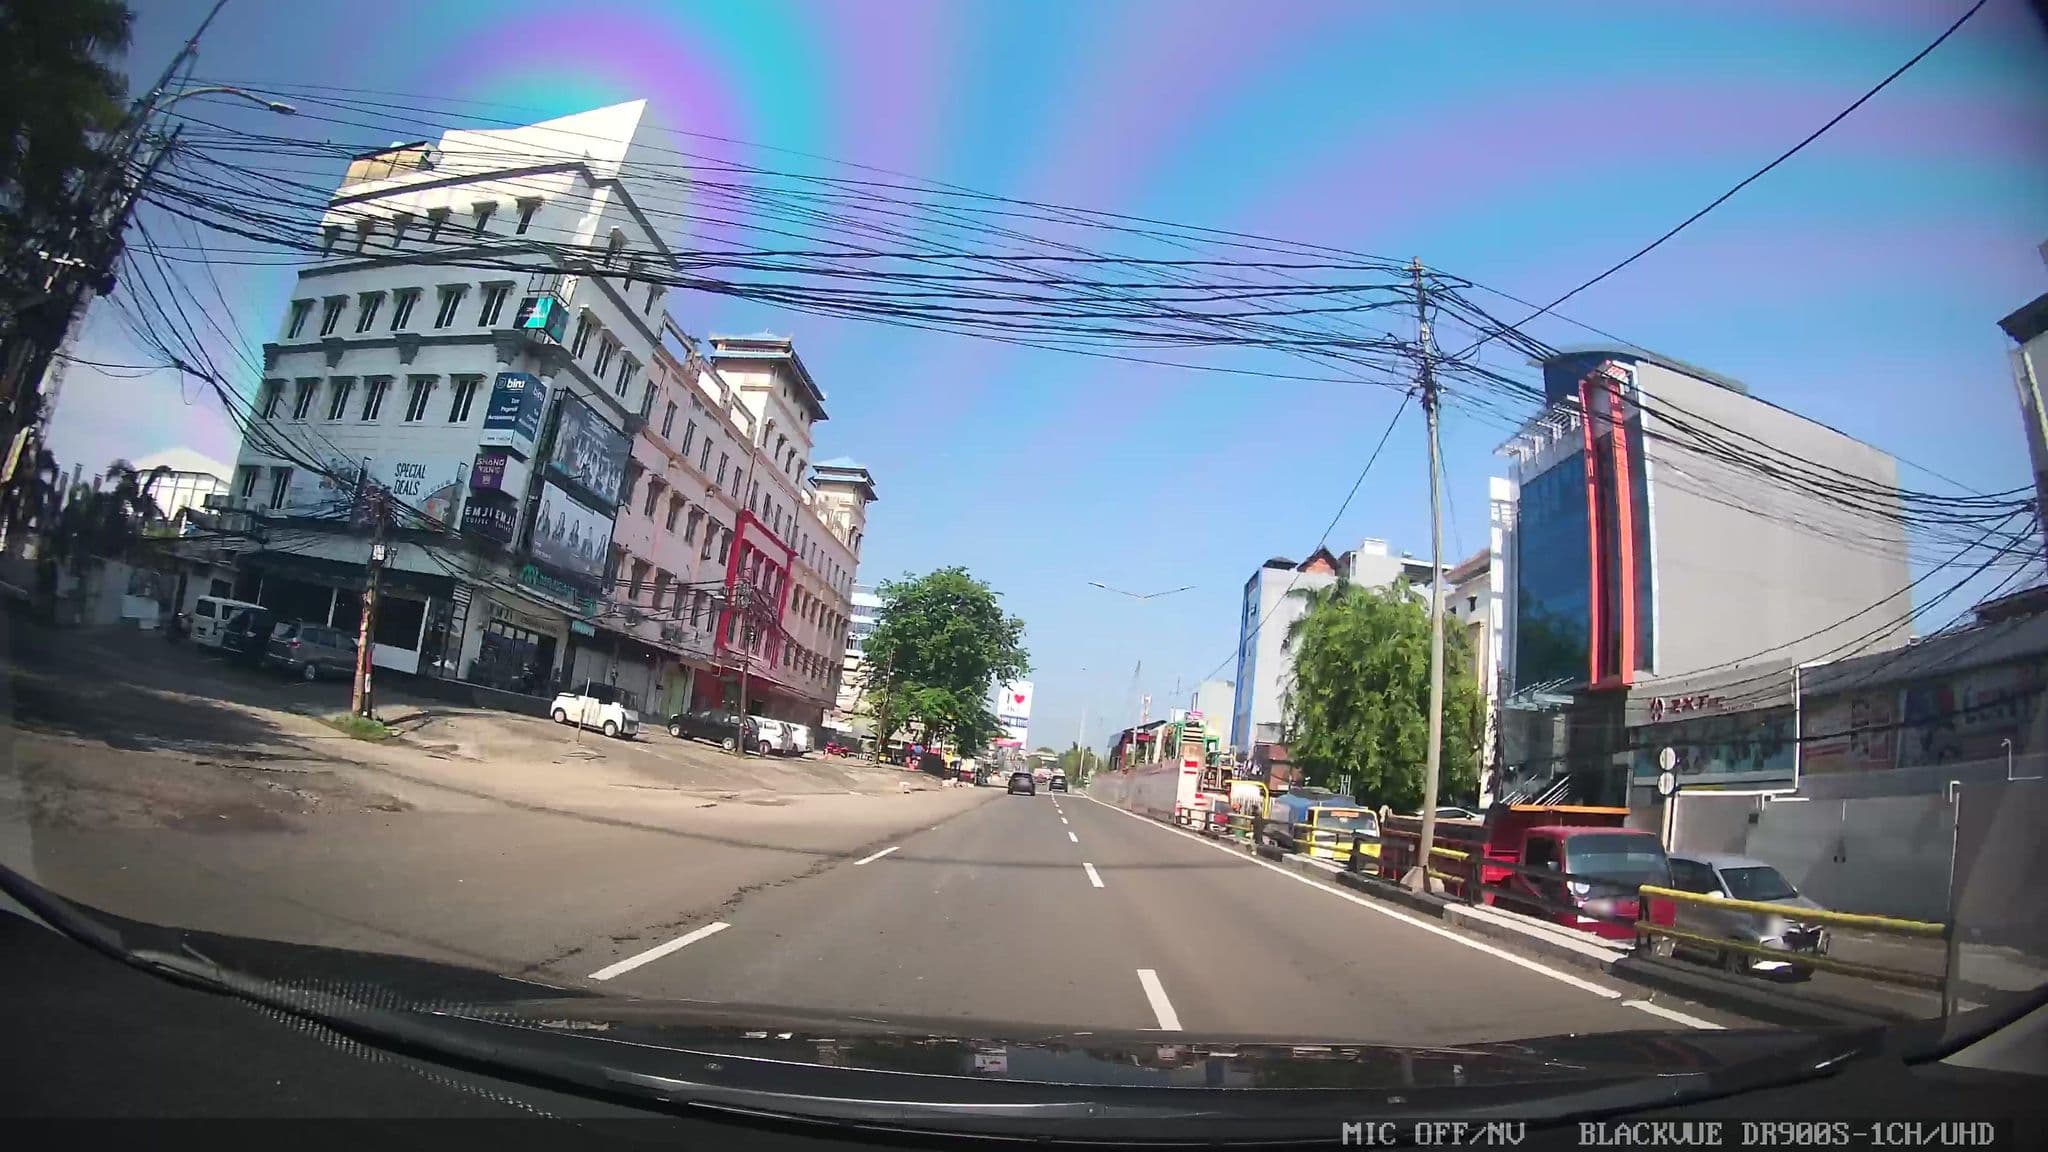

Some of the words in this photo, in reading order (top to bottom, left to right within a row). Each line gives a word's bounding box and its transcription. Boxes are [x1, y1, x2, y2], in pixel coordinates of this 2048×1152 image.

[506, 378, 525, 389] biru
[394, 462, 427, 480] SPECIAL
[393, 479, 421, 496] DEALS
[464, 506, 494, 518] EMJI
